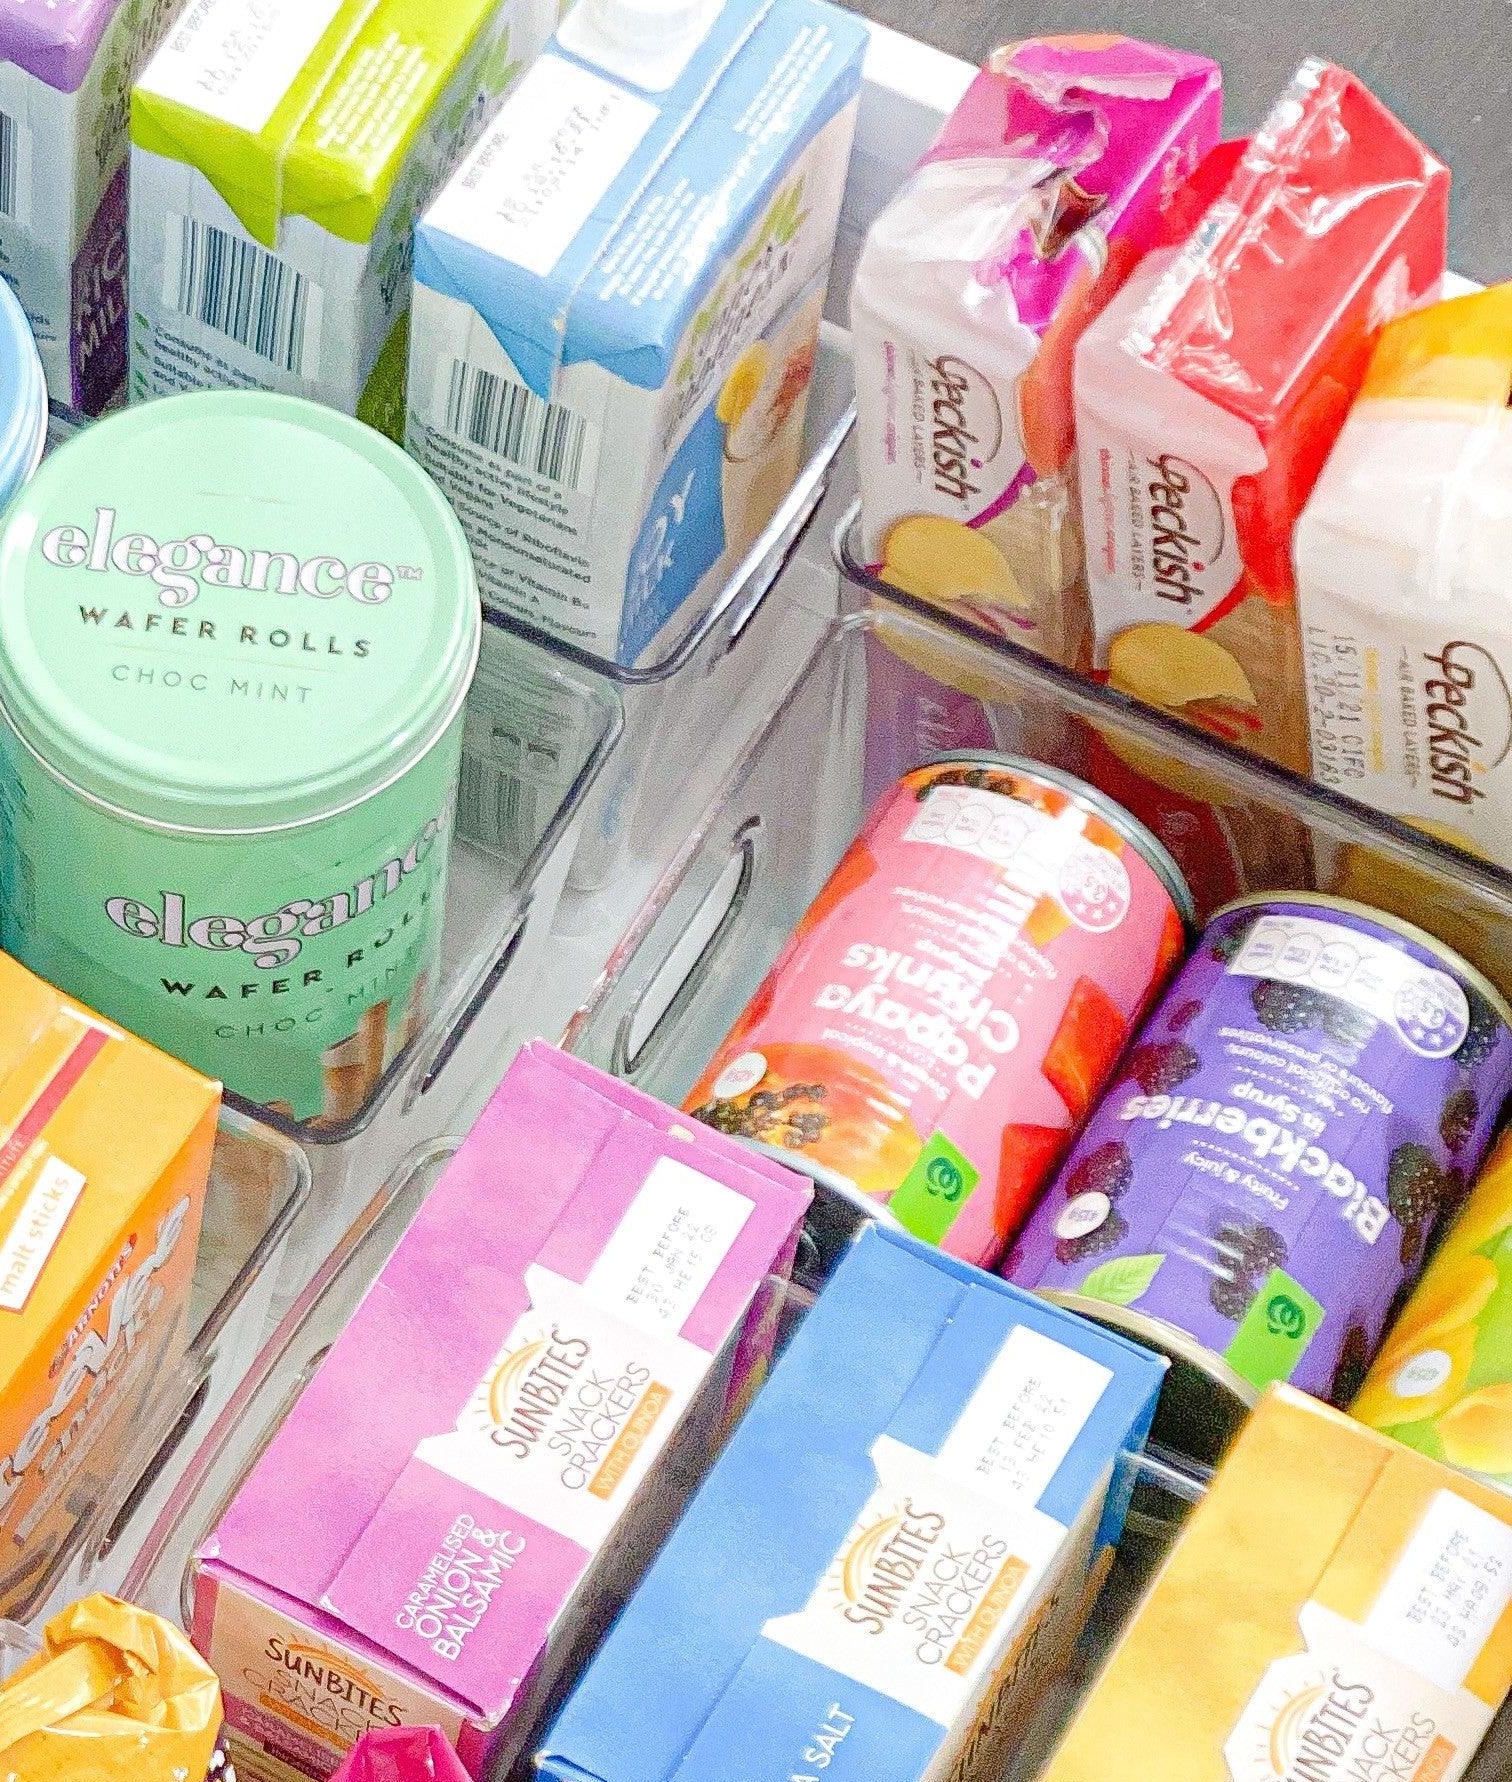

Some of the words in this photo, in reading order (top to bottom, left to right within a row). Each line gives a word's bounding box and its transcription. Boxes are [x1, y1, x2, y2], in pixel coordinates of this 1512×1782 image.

[924, 355, 1002, 500] Peckish
[1147, 453, 1224, 605] Peckish
[80, 604, 216, 640] WAFER
[240, 626, 372, 657] ROLLS
[112, 665, 209, 691] CHOC
[231, 680, 313, 704] MINT
[1424, 640, 1512, 805] Peckish
[161, 969, 322, 999] WAFER
[215, 1007, 323, 1039] CHOC
[842, 942, 1019, 1053] Chunks
[815, 983, 997, 1099] Papaya
[1231, 1081, 1300, 1129] Syrup
[1300, 1106, 1326, 1133] in
[1119, 1093, 1391, 1246] Blackberries
[1181, 1144, 1228, 1182] juicy
[1235, 1171, 1293, 1214] Fruity
[0, 1238, 35, 1299] malt
[28, 1174, 72, 1241] sticks
[491, 1330, 589, 1459] SUNBITES
[546, 1376, 612, 1457] SNACK
[559, 1361, 650, 1491] CRACKERS
[594, 1450, 628, 1493] WITH
[617, 1389, 665, 1457] QUINOA
[395, 1513, 475, 1630] CARAMELISED
[414, 1550, 487, 1642] ONION
[477, 1526, 502, 1550] &
[434, 1531, 528, 1662] BALSAMIC
[844, 1503, 945, 1636] SUNBITES
[903, 1545, 970, 1633] SNACK
[917, 1533, 1008, 1666] CRACKERS
[951, 1623, 989, 1669] WITH
[975, 1560, 1025, 1631] QUINOA
[265, 1637, 404, 1727] SUNBITES
[803, 1703, 859, 1770] SALT
